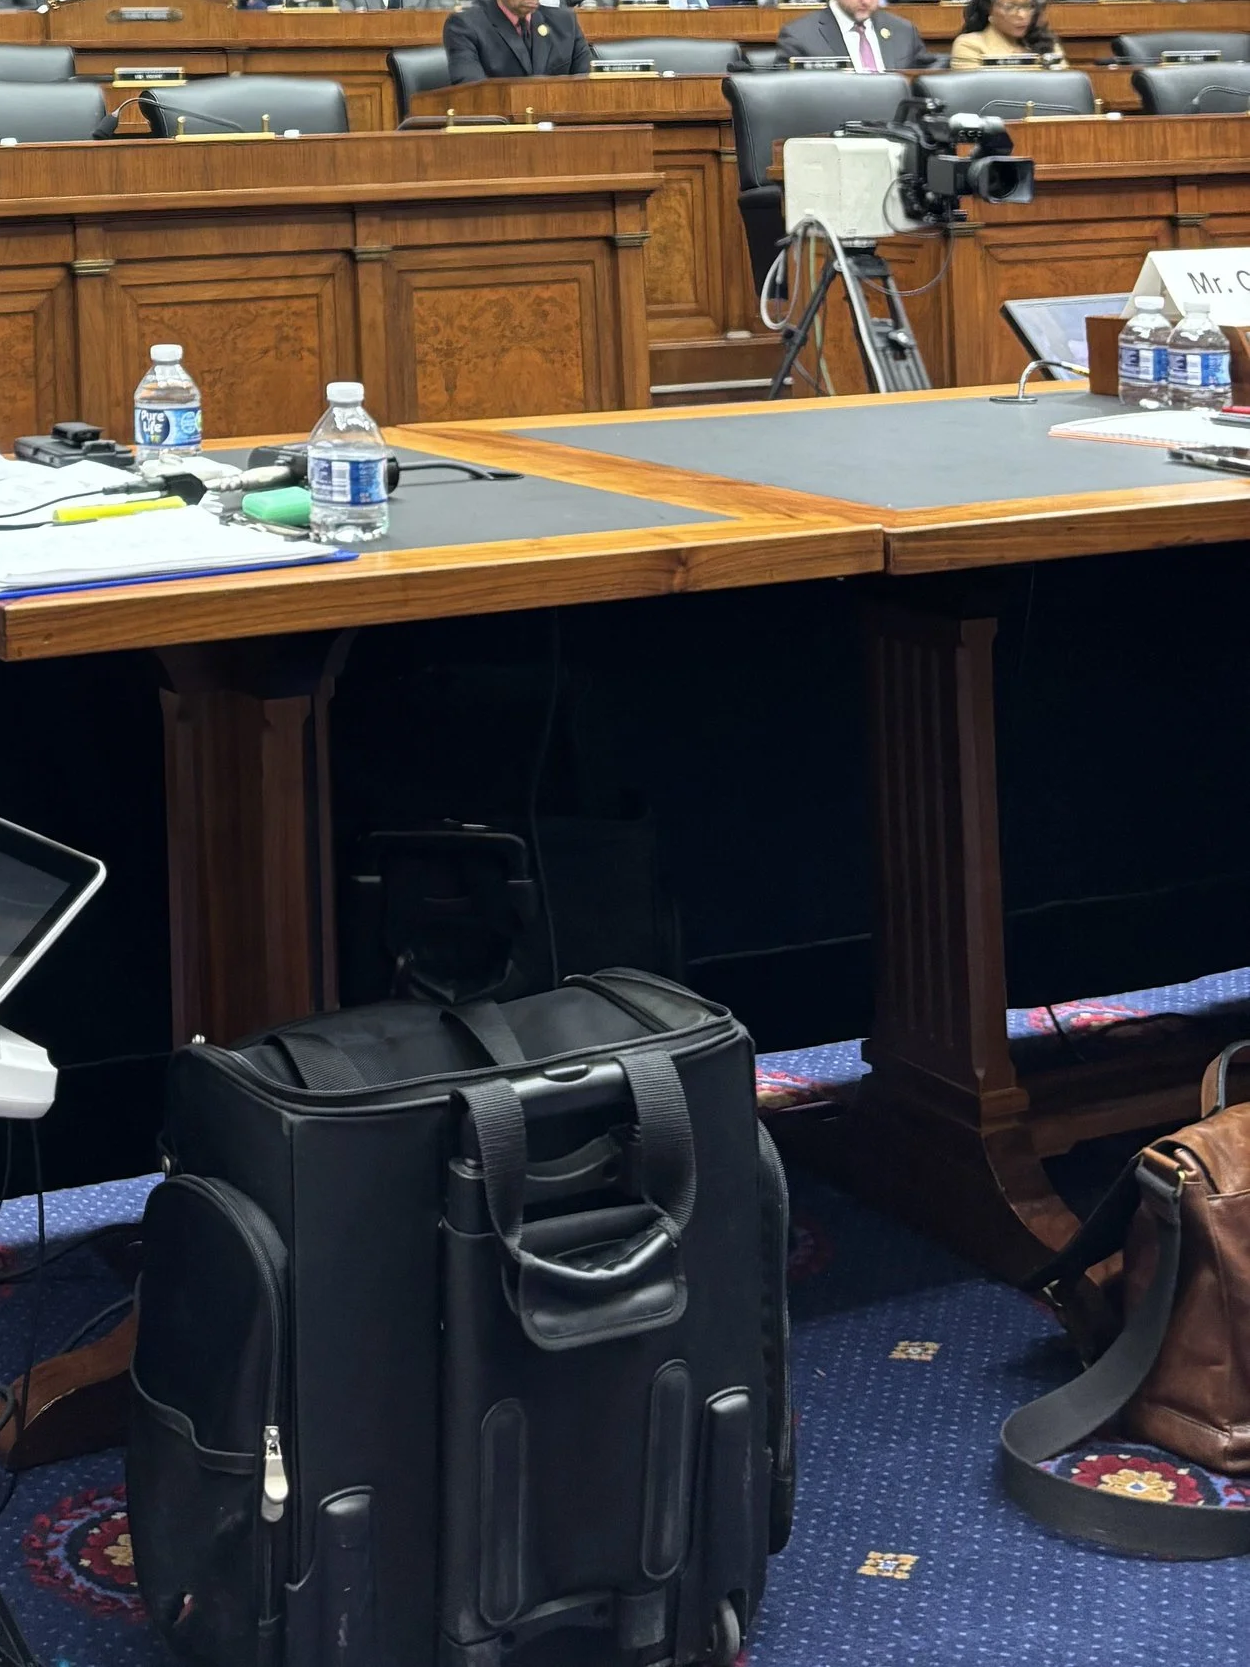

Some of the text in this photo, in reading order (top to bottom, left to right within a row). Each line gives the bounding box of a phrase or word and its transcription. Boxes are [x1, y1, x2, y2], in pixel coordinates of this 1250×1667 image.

[1186, 271, 1233, 294] Mr.
[141, 410, 164, 422] Pure
[143, 421, 163, 434] Life
